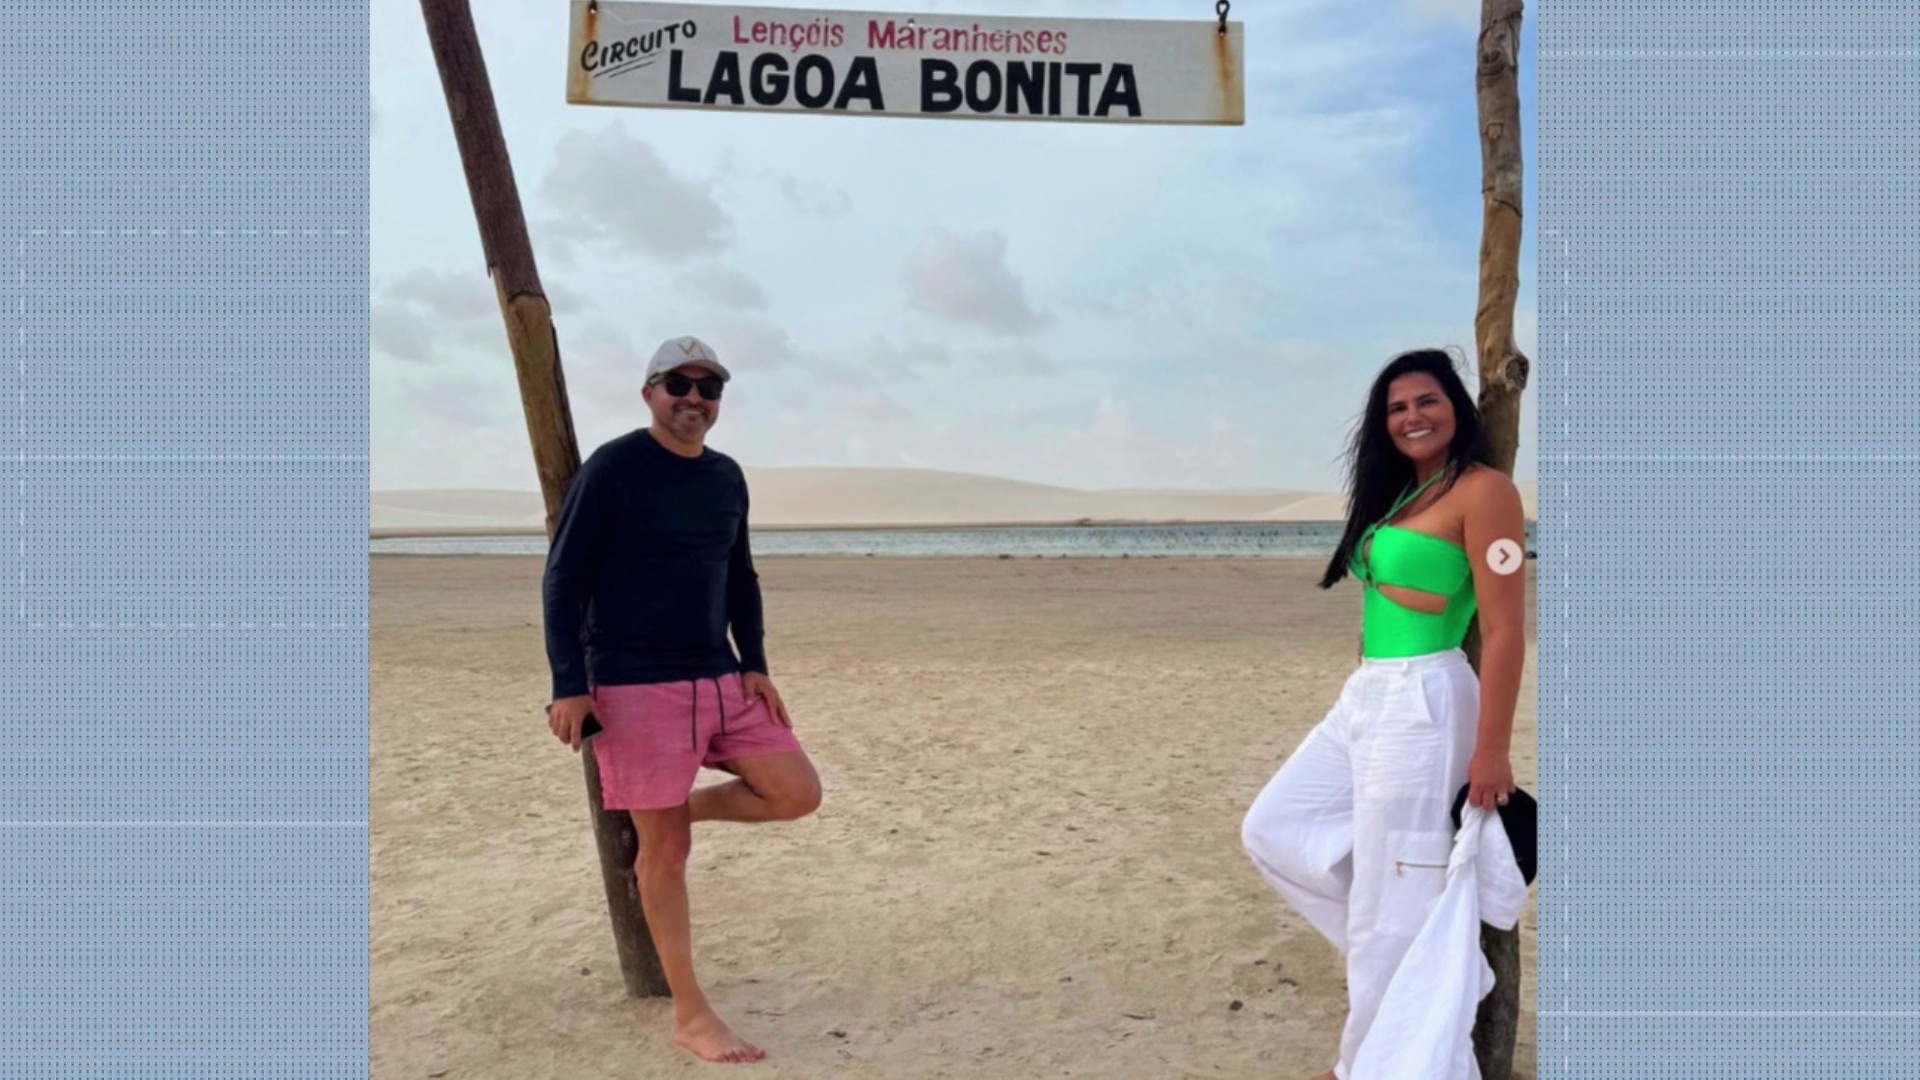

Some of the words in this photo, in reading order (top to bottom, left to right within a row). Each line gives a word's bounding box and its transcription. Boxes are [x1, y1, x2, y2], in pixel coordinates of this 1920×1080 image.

[580, 19, 698, 72] CIRCUITO
[733, 15, 844, 53] Lençóis
[867, 19, 1068, 54] Maranhenses
[667, 48, 885, 111] LAGOA
[920, 58, 1142, 117] BONITA
